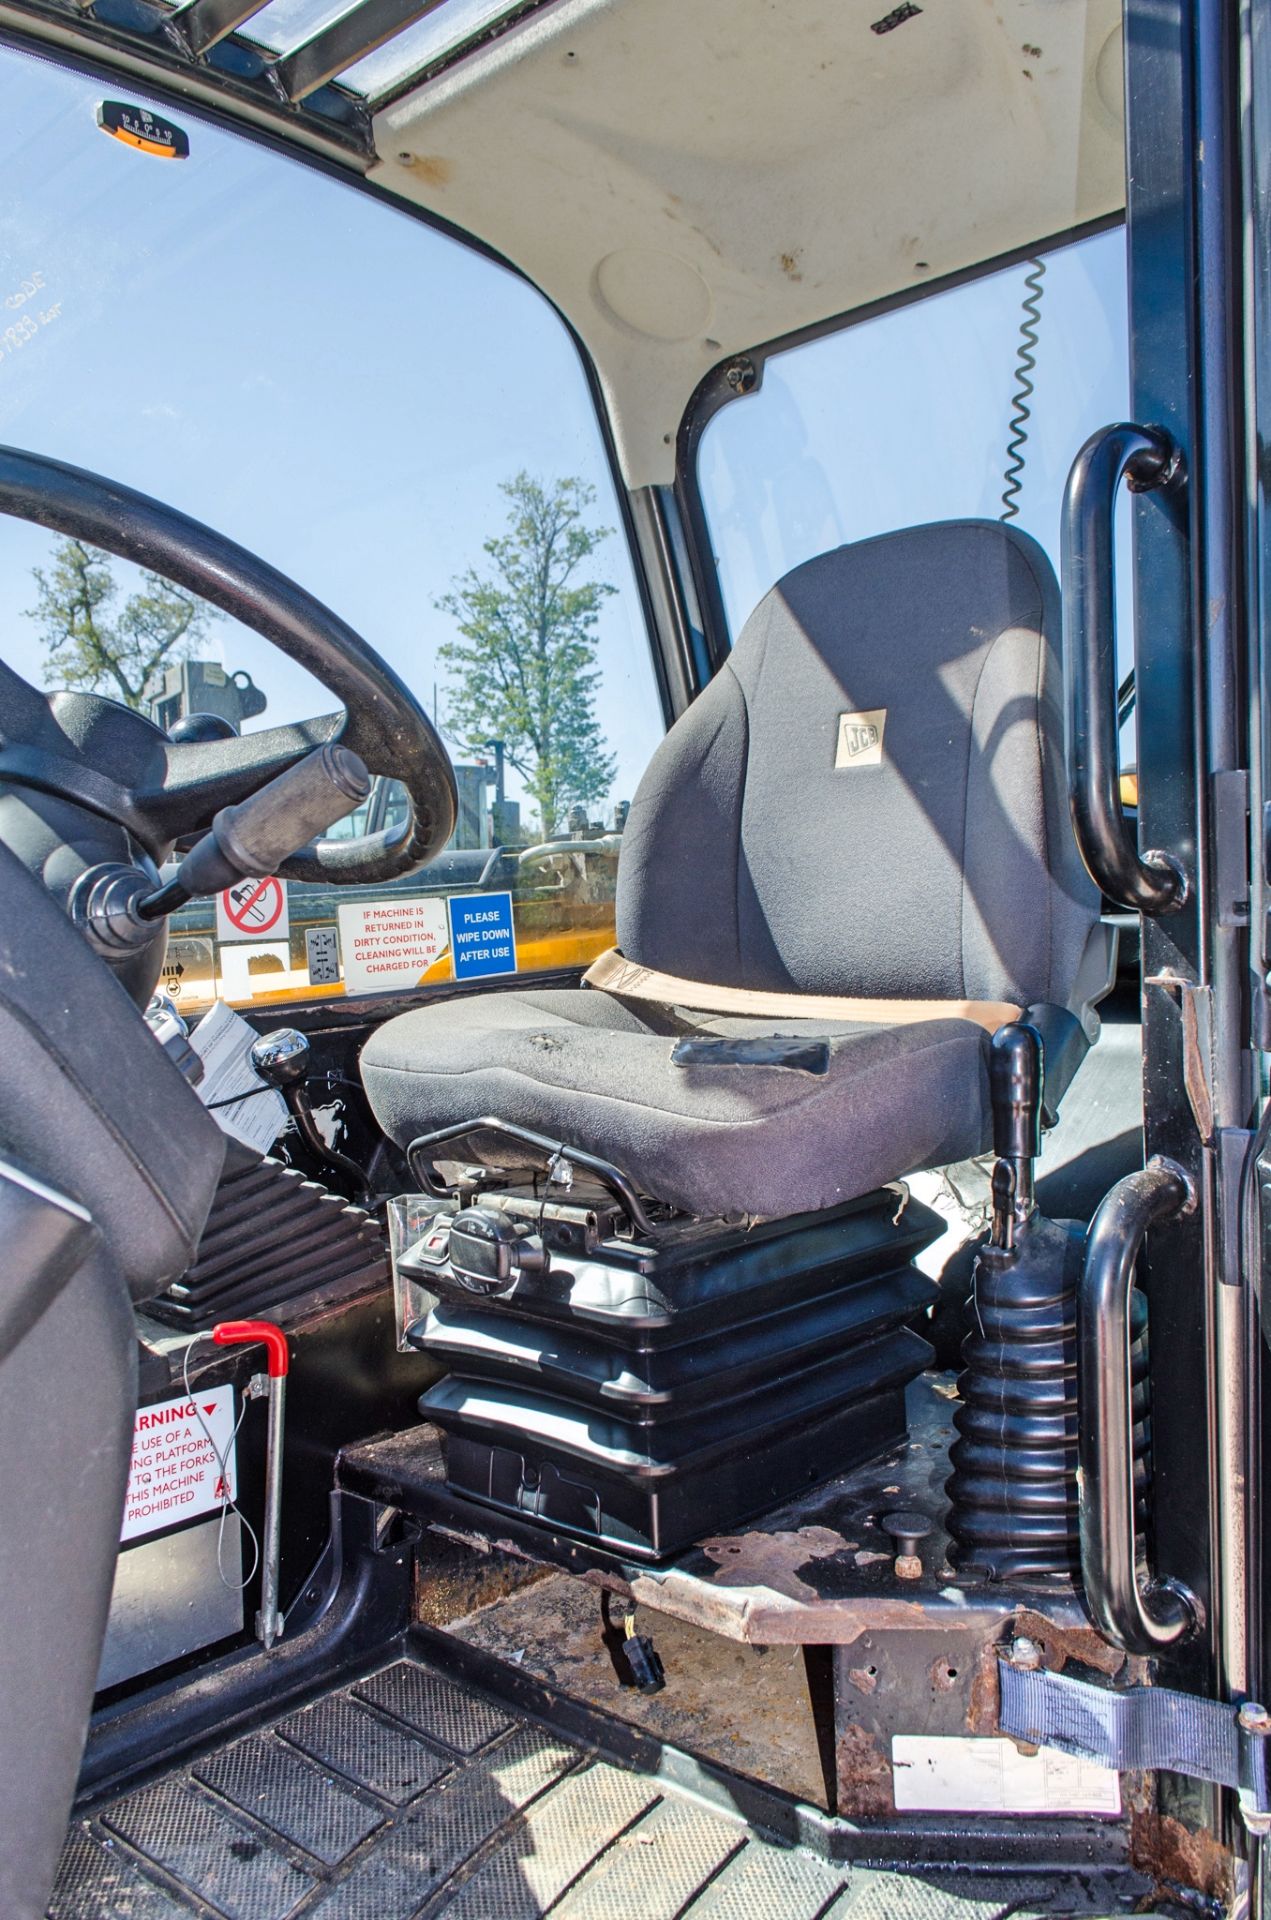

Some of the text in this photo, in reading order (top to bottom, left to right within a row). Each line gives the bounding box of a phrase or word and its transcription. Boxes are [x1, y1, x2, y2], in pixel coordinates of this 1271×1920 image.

[849, 727, 876, 753] JCB
[363, 907, 424, 920] IF MACHINE IS
[464, 911, 500, 924] PLEASE
[365, 919, 424, 933] RETURNED IN
[354, 933, 436, 948] DIRTY CONDITION,
[456, 928, 510, 944] WIPE DOWN
[355, 945, 437, 961] CLEANING WILL BE
[460, 946, 510, 963] AFTER USE
[366, 959, 429, 974] CHARGED FOR
[134, 1402, 197, 1432] RNING
[142, 1435, 162, 1451] USE
[166, 1431, 180, 1444] OF
[184, 1428, 192, 1438] A
[130, 1437, 213, 1471] ING PLATFORM
[134, 1472, 152, 1486] TO
[155, 1464, 177, 1480] THE
[180, 1452, 215, 1473] FORKS
[152, 1470, 205, 1496] MACHINE
[127, 1490, 195, 1521] PROHIBITED
